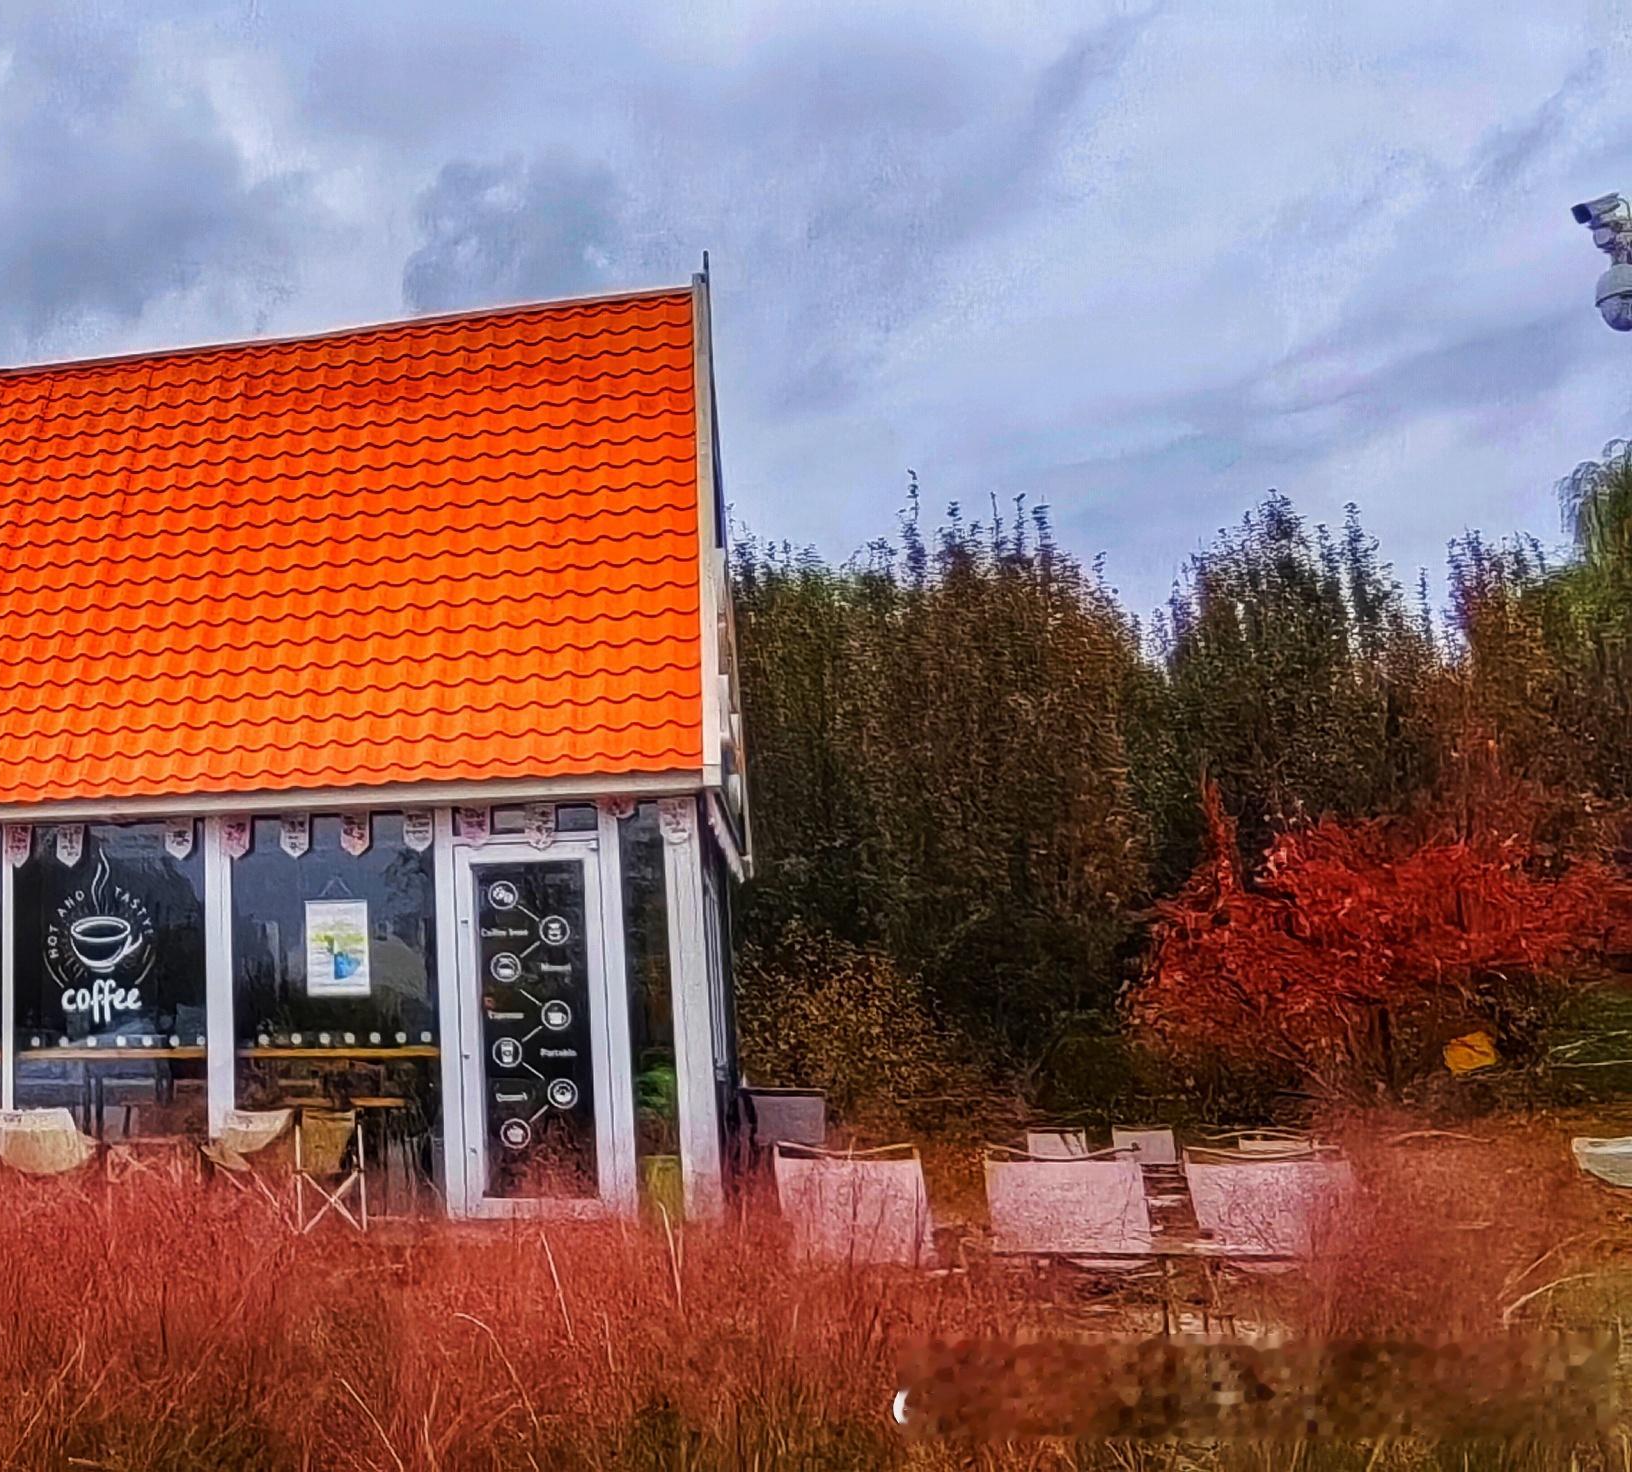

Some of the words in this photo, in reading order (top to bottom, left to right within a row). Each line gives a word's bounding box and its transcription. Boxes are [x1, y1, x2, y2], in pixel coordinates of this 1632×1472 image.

[48, 924, 59, 958] HOT
[57, 890, 85, 918] AND
[61, 979, 142, 1024] coffee
